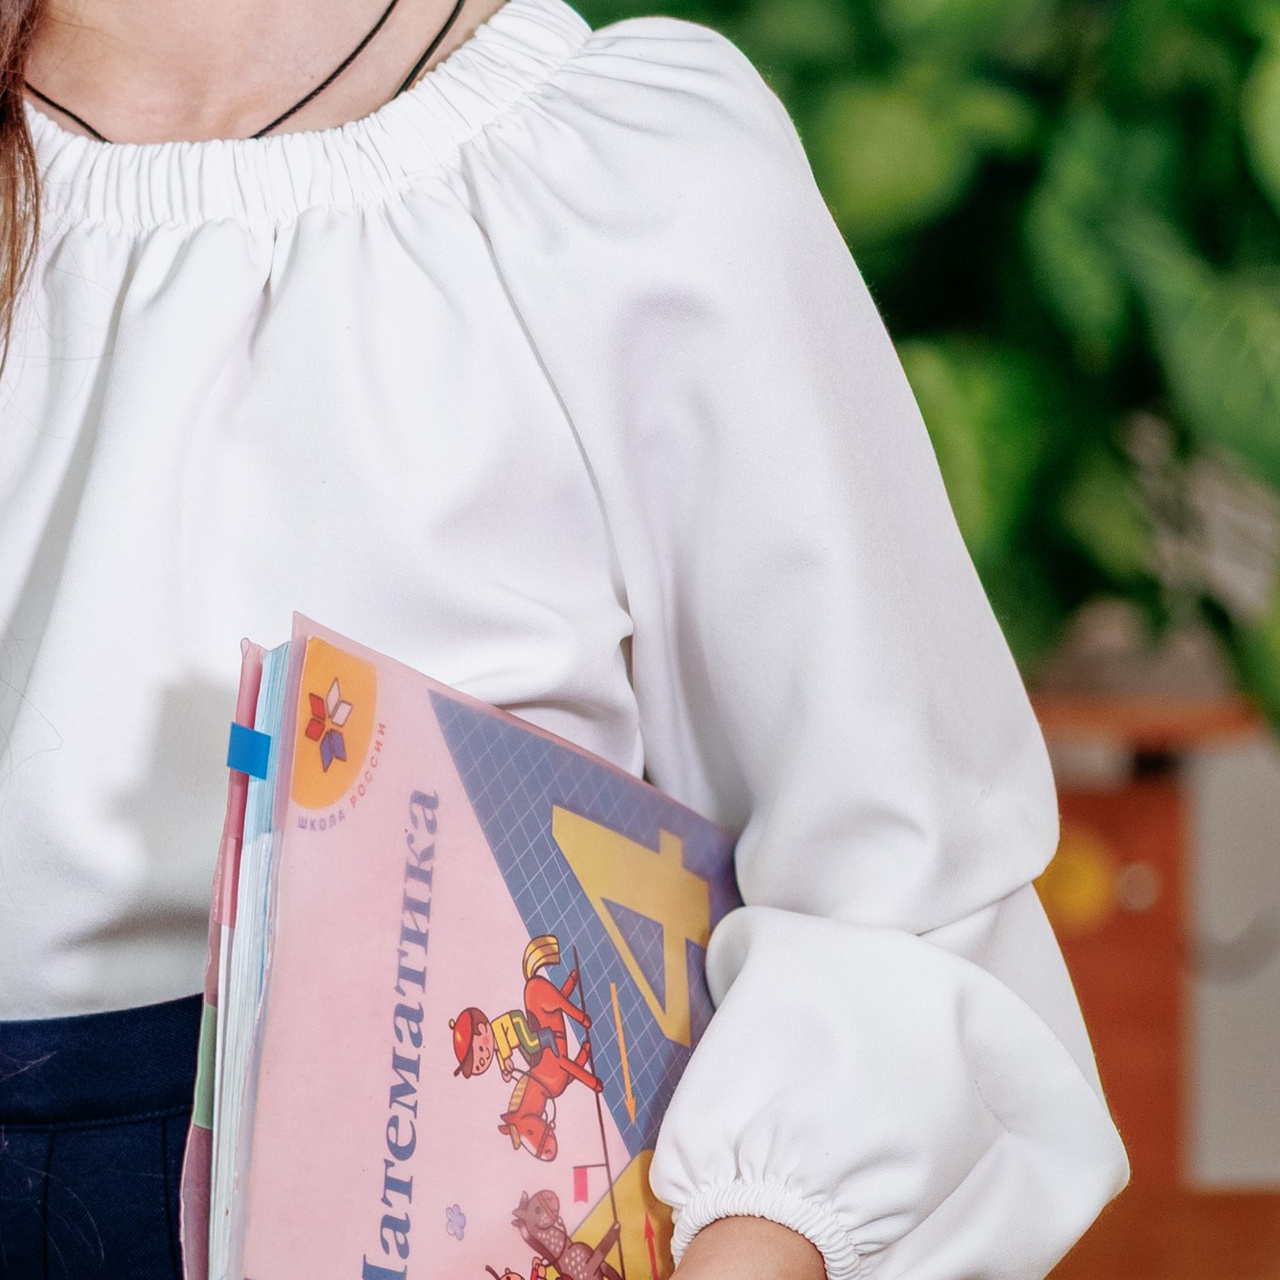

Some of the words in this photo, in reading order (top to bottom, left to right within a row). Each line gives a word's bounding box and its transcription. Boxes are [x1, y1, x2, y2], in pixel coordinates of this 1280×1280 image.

[297, 808, 346, 832] ШКОЛА
[349, 721, 387, 809] РОССИИ
[551, 804, 711, 1049] 4
